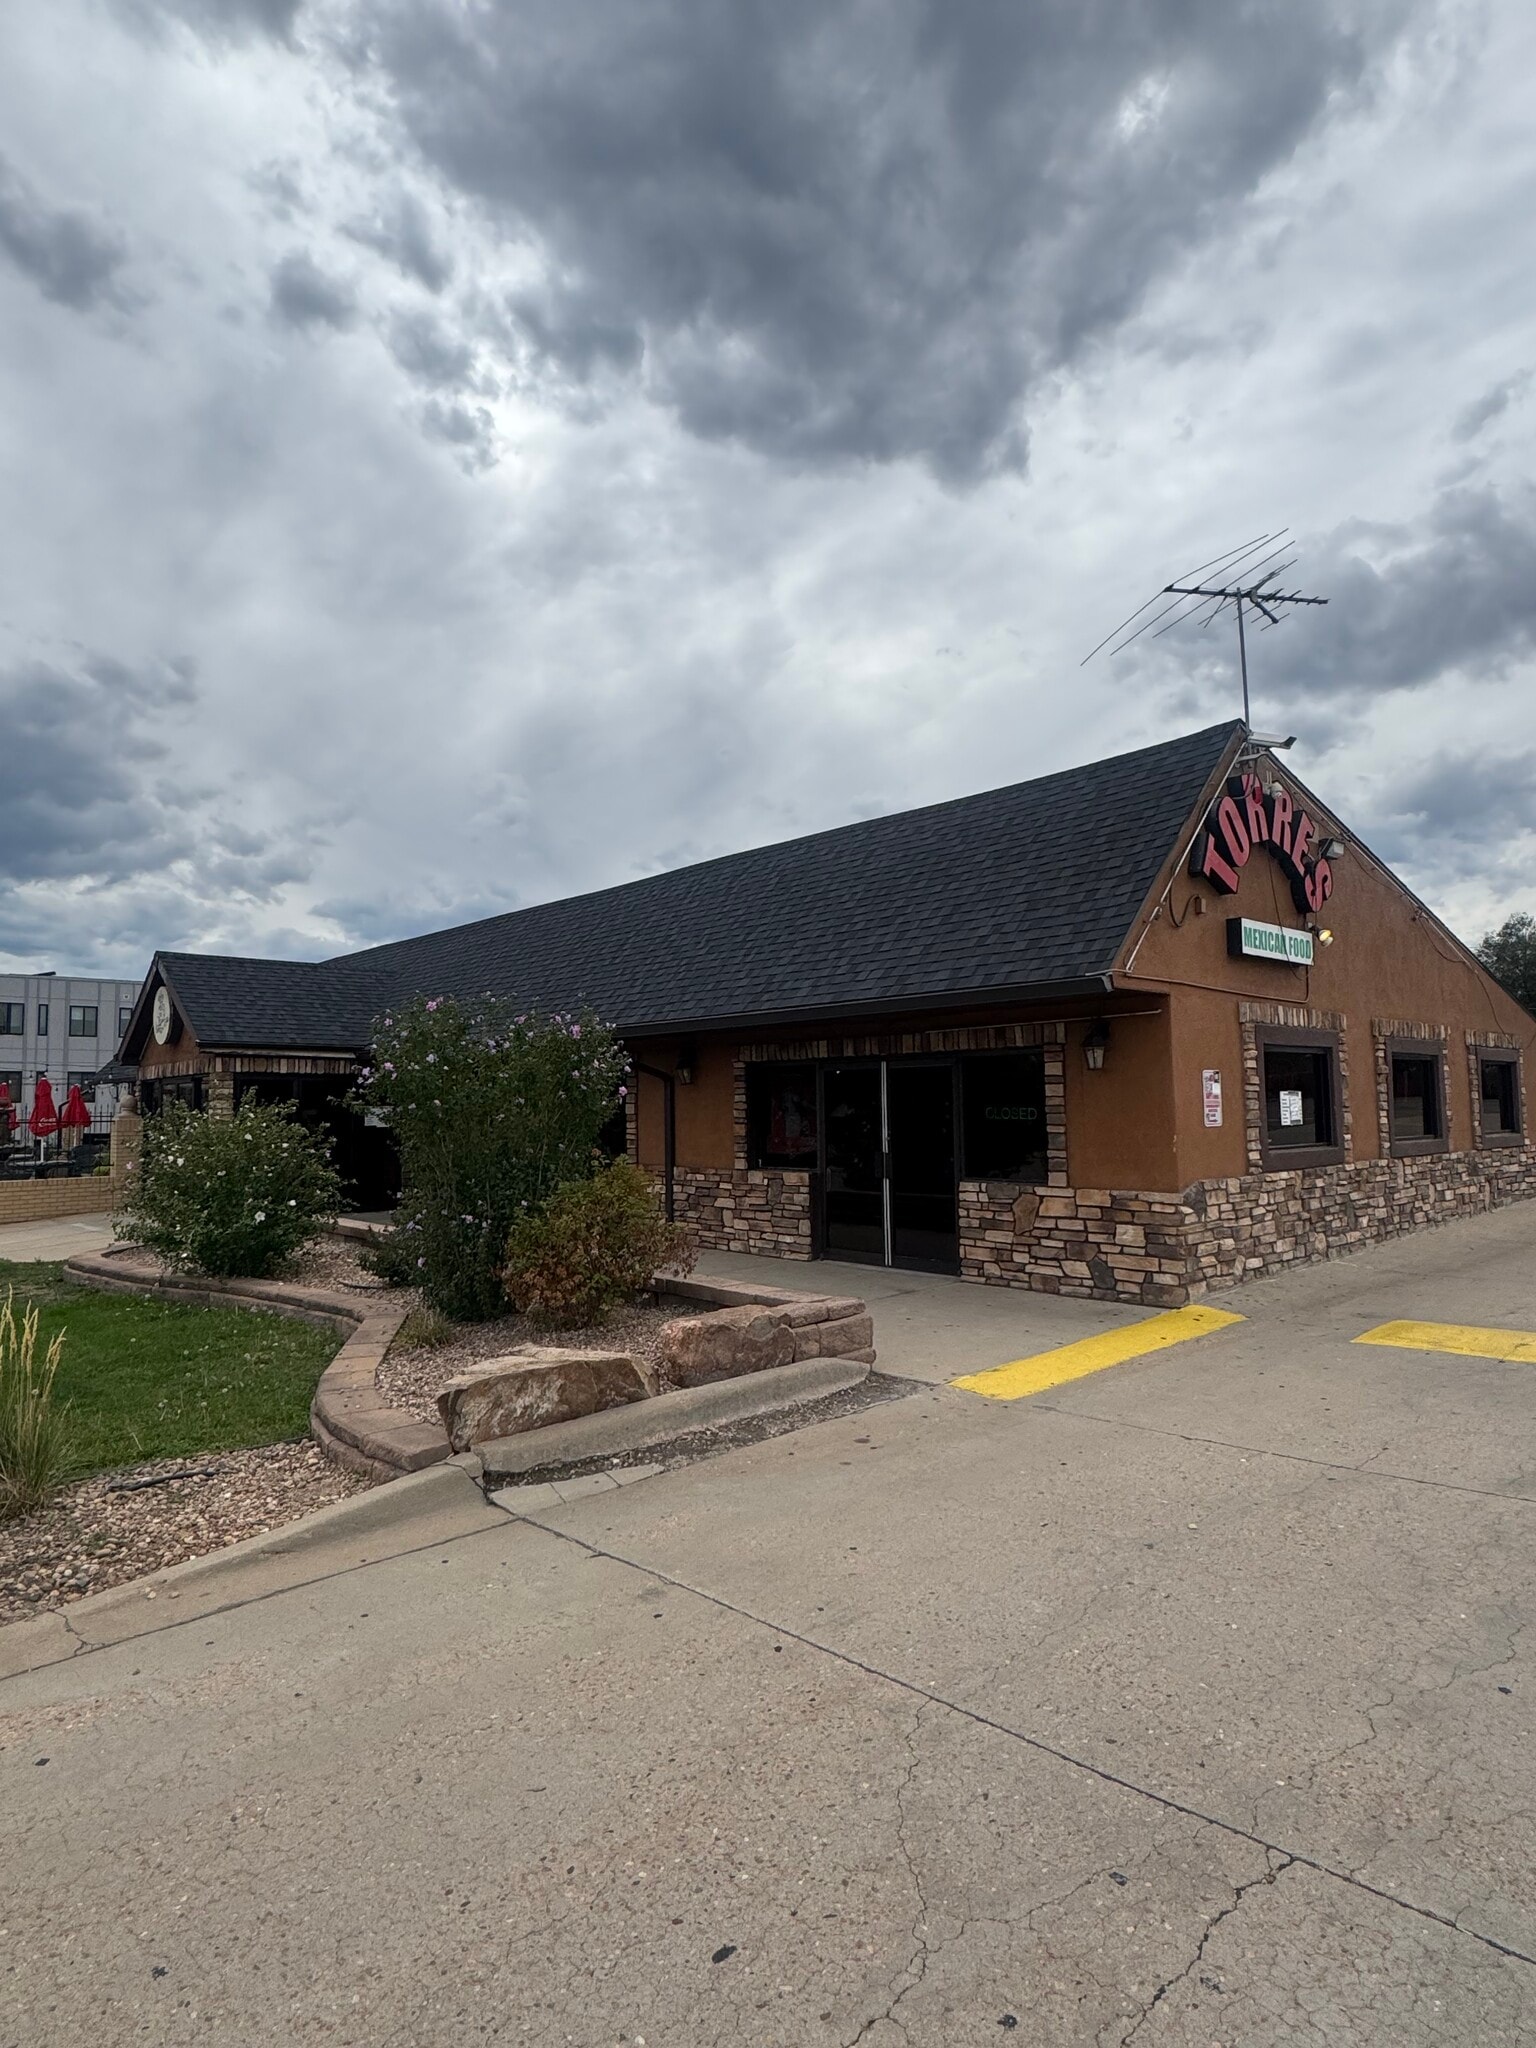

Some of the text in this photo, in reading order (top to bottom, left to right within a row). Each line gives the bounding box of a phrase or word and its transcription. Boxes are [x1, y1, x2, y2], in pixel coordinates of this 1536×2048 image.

[1201, 773, 1334, 913] TORRES
[1243, 926, 1312, 960] MEXICAN FOOD
[985, 1106, 1038, 1120] CLOSED
